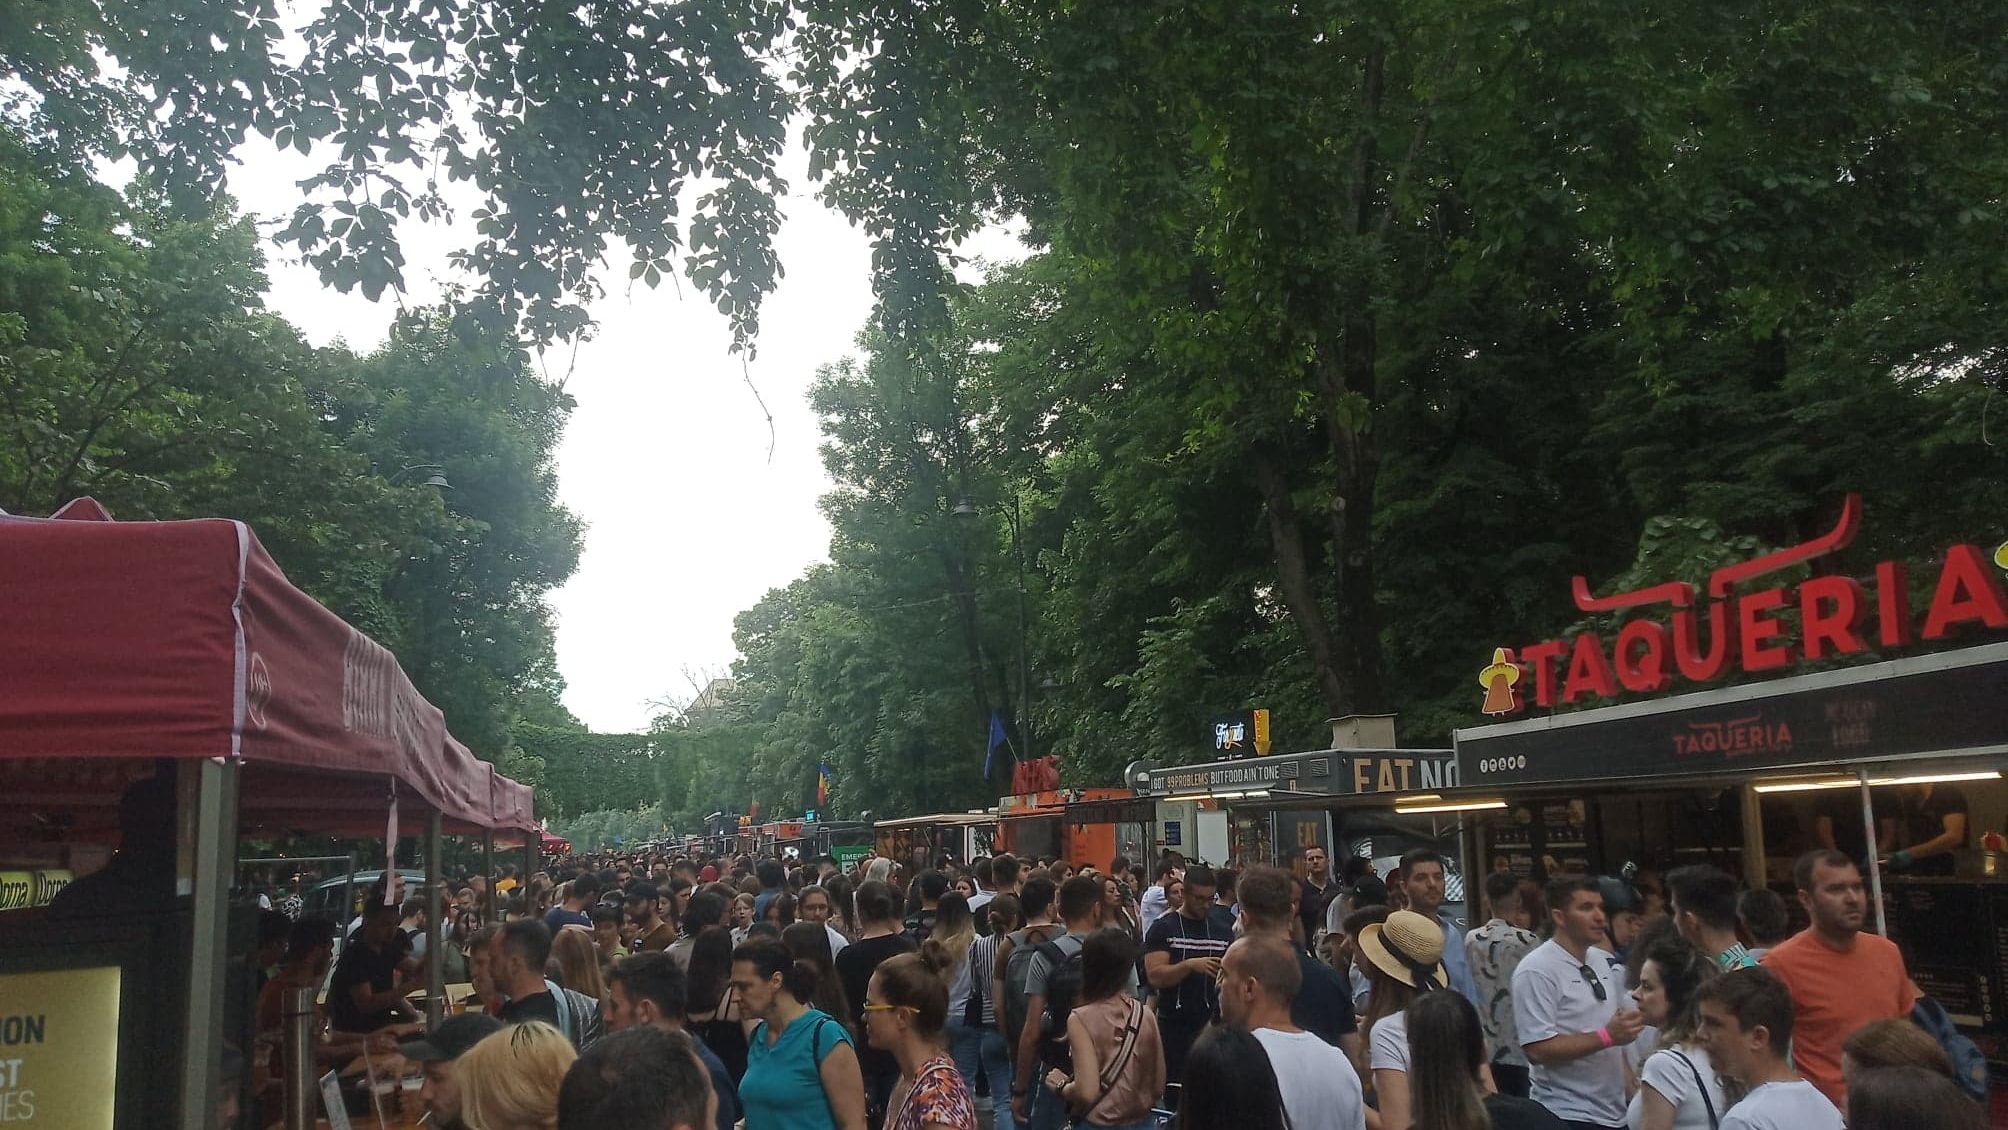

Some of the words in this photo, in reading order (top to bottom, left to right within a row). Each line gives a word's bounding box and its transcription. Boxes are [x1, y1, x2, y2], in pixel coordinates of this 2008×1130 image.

[1521, 540, 2008, 708] TAQUERIA
[1671, 721, 1793, 754] TAQUERIA
[1354, 758, 1413, 794] EAT
[37, 871, 68, 905] Dorn
